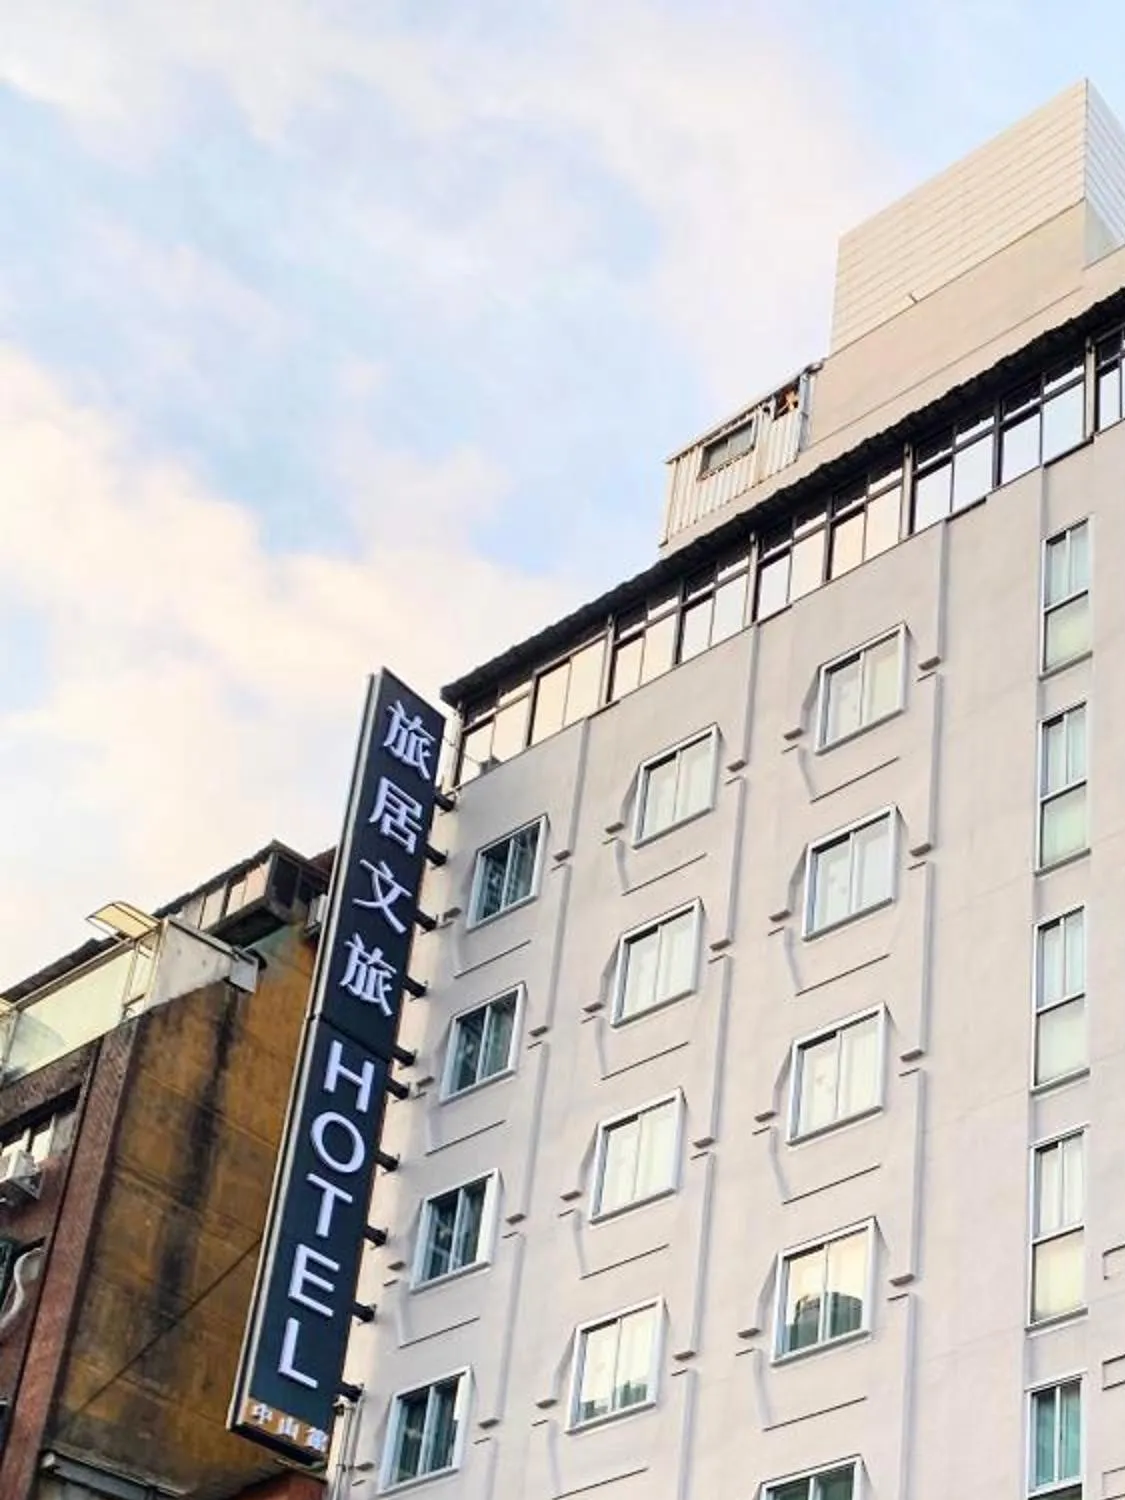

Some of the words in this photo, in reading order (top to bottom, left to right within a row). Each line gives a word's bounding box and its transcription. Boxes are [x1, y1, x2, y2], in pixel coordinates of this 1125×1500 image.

[339, 700, 437, 1017] 旅居文旅
[277, 1039, 375, 1390] HOTEL
